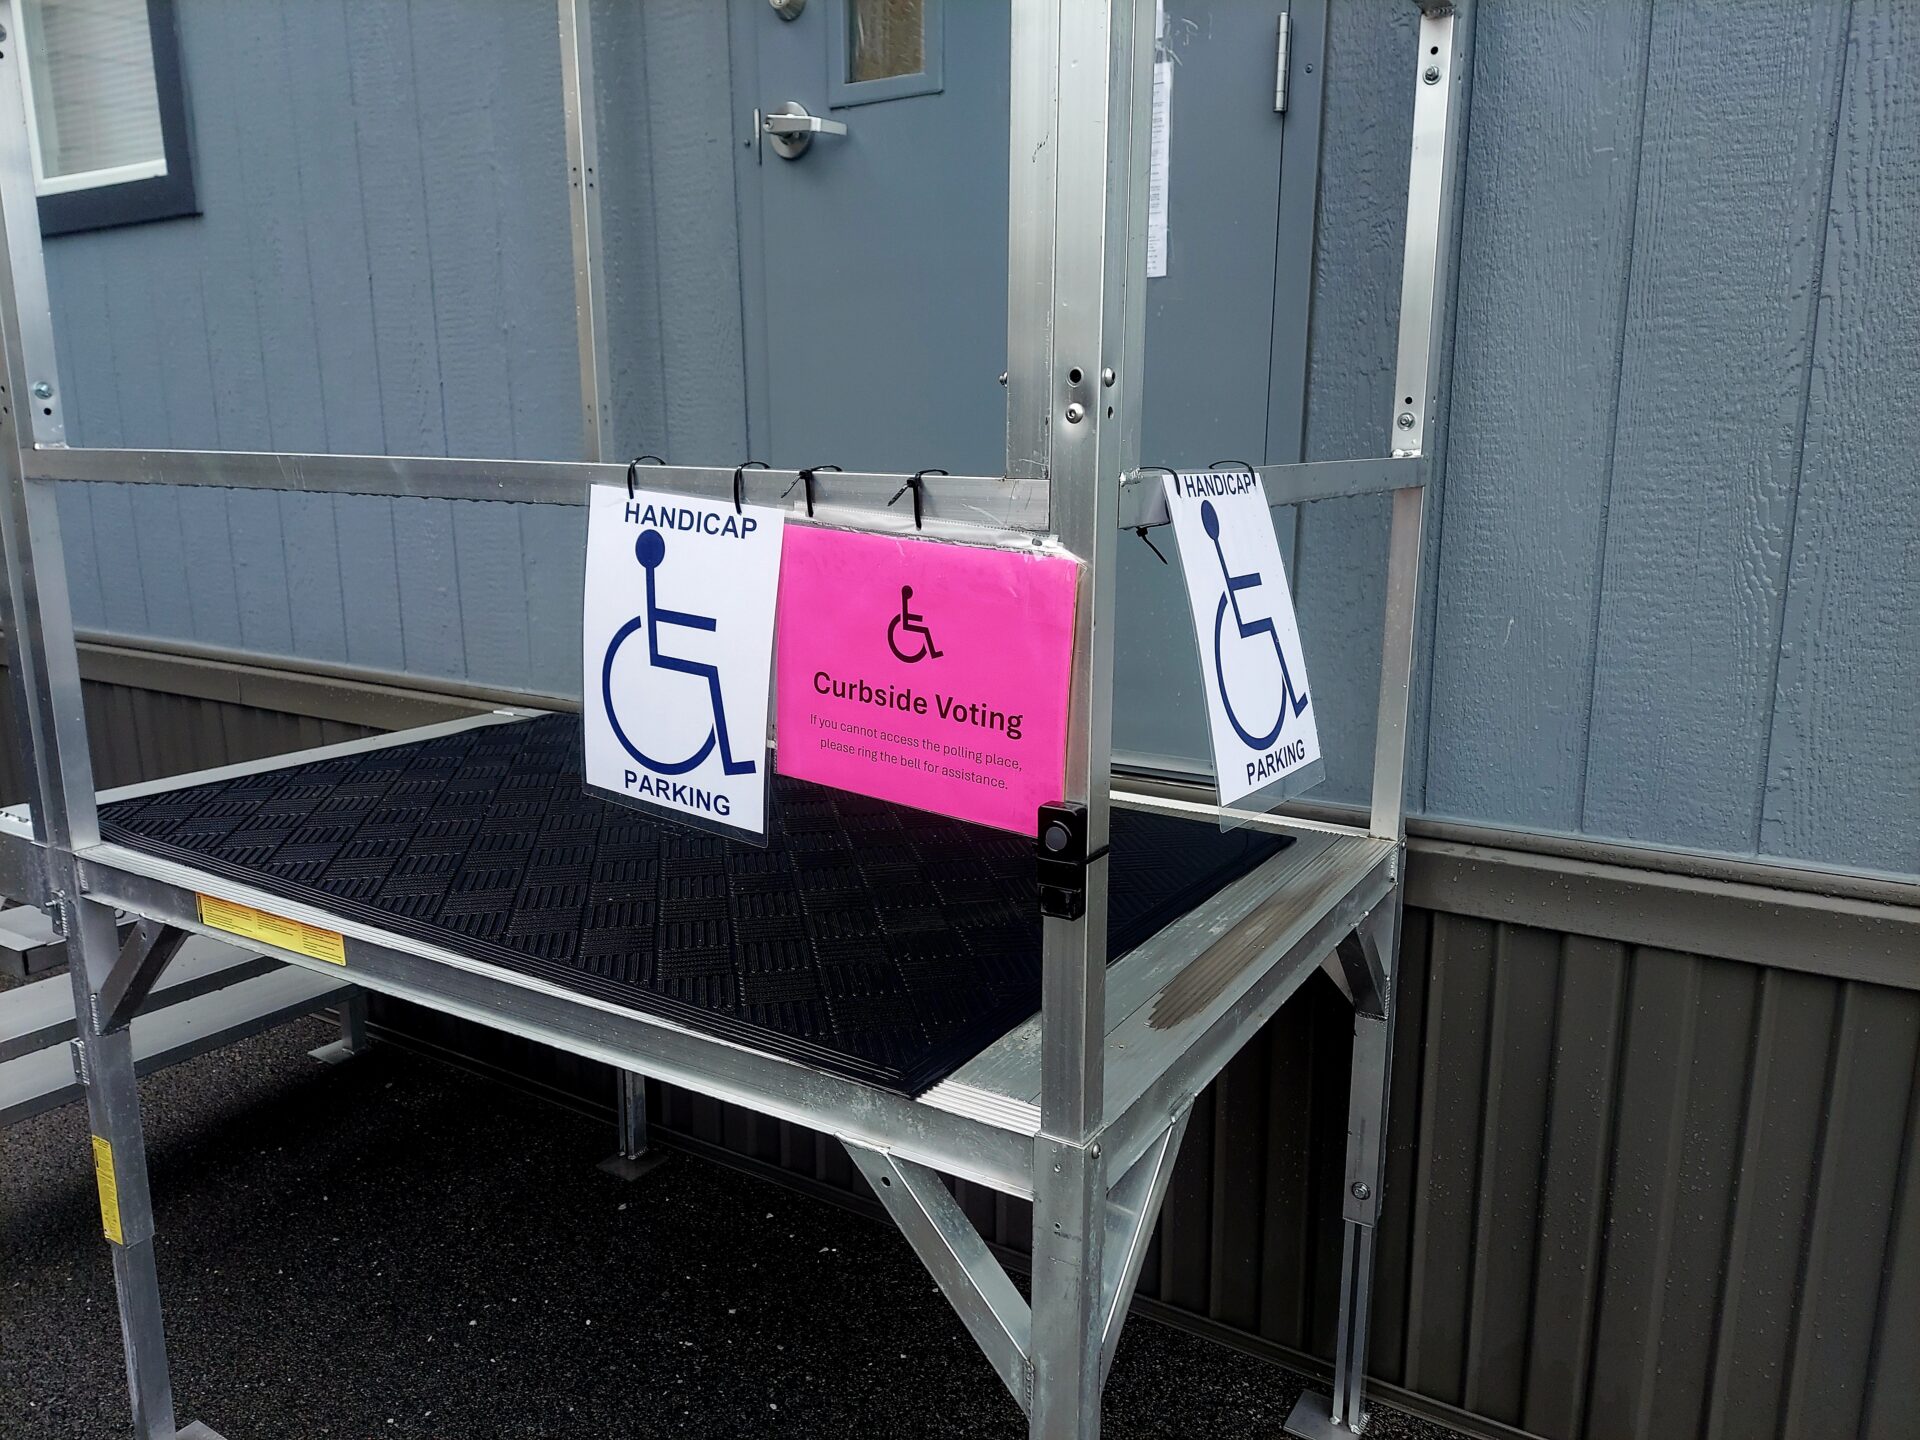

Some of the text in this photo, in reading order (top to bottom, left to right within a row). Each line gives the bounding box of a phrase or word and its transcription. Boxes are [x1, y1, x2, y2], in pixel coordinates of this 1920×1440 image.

[1184, 474, 1252, 497] HANDICAP
[625, 502, 757, 539] HANDICAP
[814, 671, 1023, 740] Curbside Voting
[810, 714, 1022, 772] If you cannot access the polling place,
[820, 739, 1008, 790] please ring the bell for assistance.
[1246, 739, 1305, 786] PARKING
[624, 769, 730, 816] PARKING
